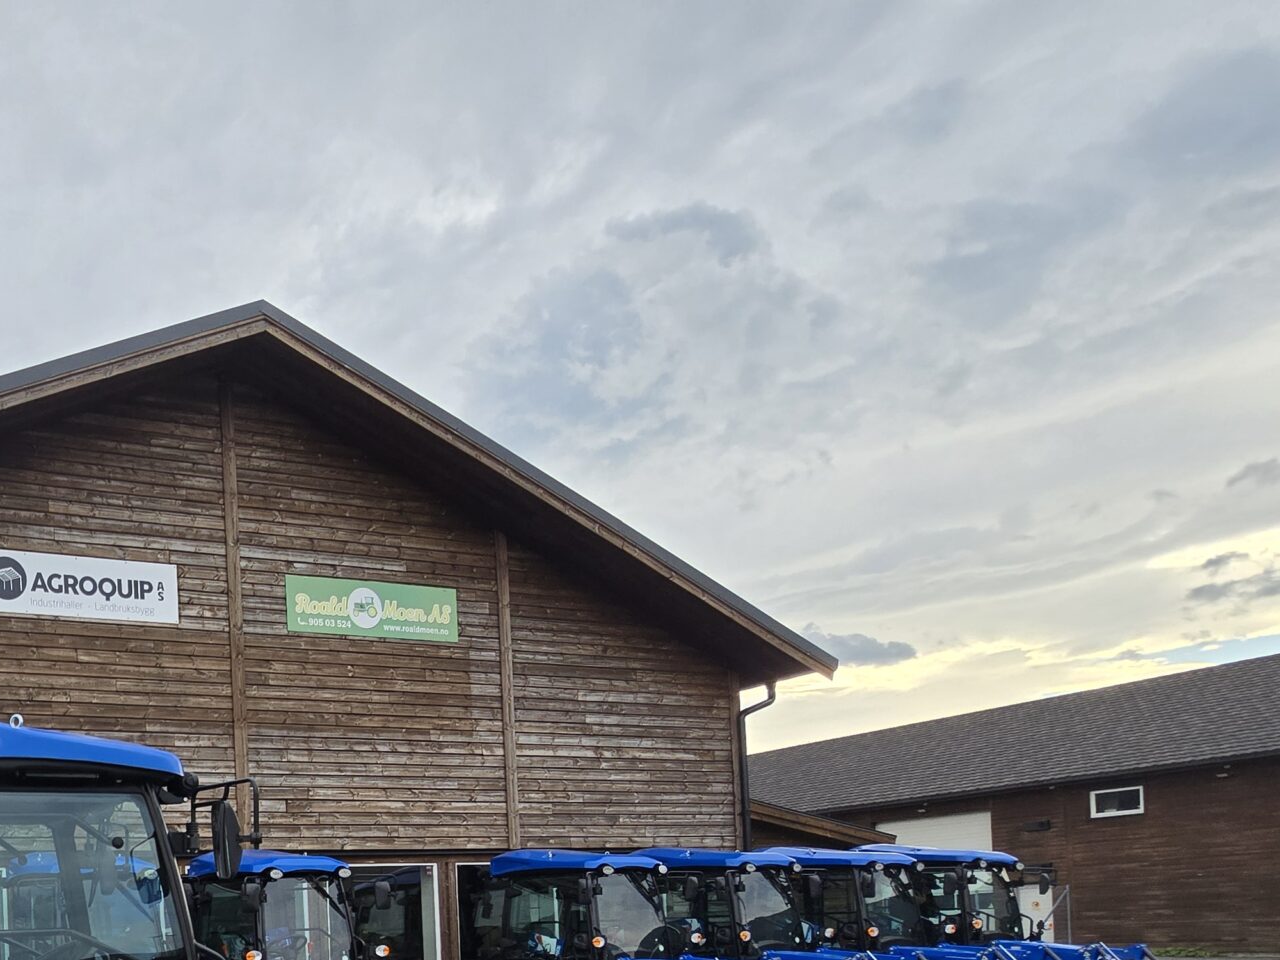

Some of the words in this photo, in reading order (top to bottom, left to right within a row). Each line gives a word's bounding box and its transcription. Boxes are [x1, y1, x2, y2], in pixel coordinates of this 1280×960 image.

[31, 572, 154, 601] AGROQUIP
[94, 602, 155, 616] Landbruksbygg
[295, 592, 348, 616] Roald
[382, 600, 426, 622] Moen
[428, 604, 451, 624] AS
[308, 617, 324, 627] 905
[325, 619, 335, 628] 03
[337, 620, 352, 629] 524
[383, 624, 449, 636] www.roaldmoen.no
